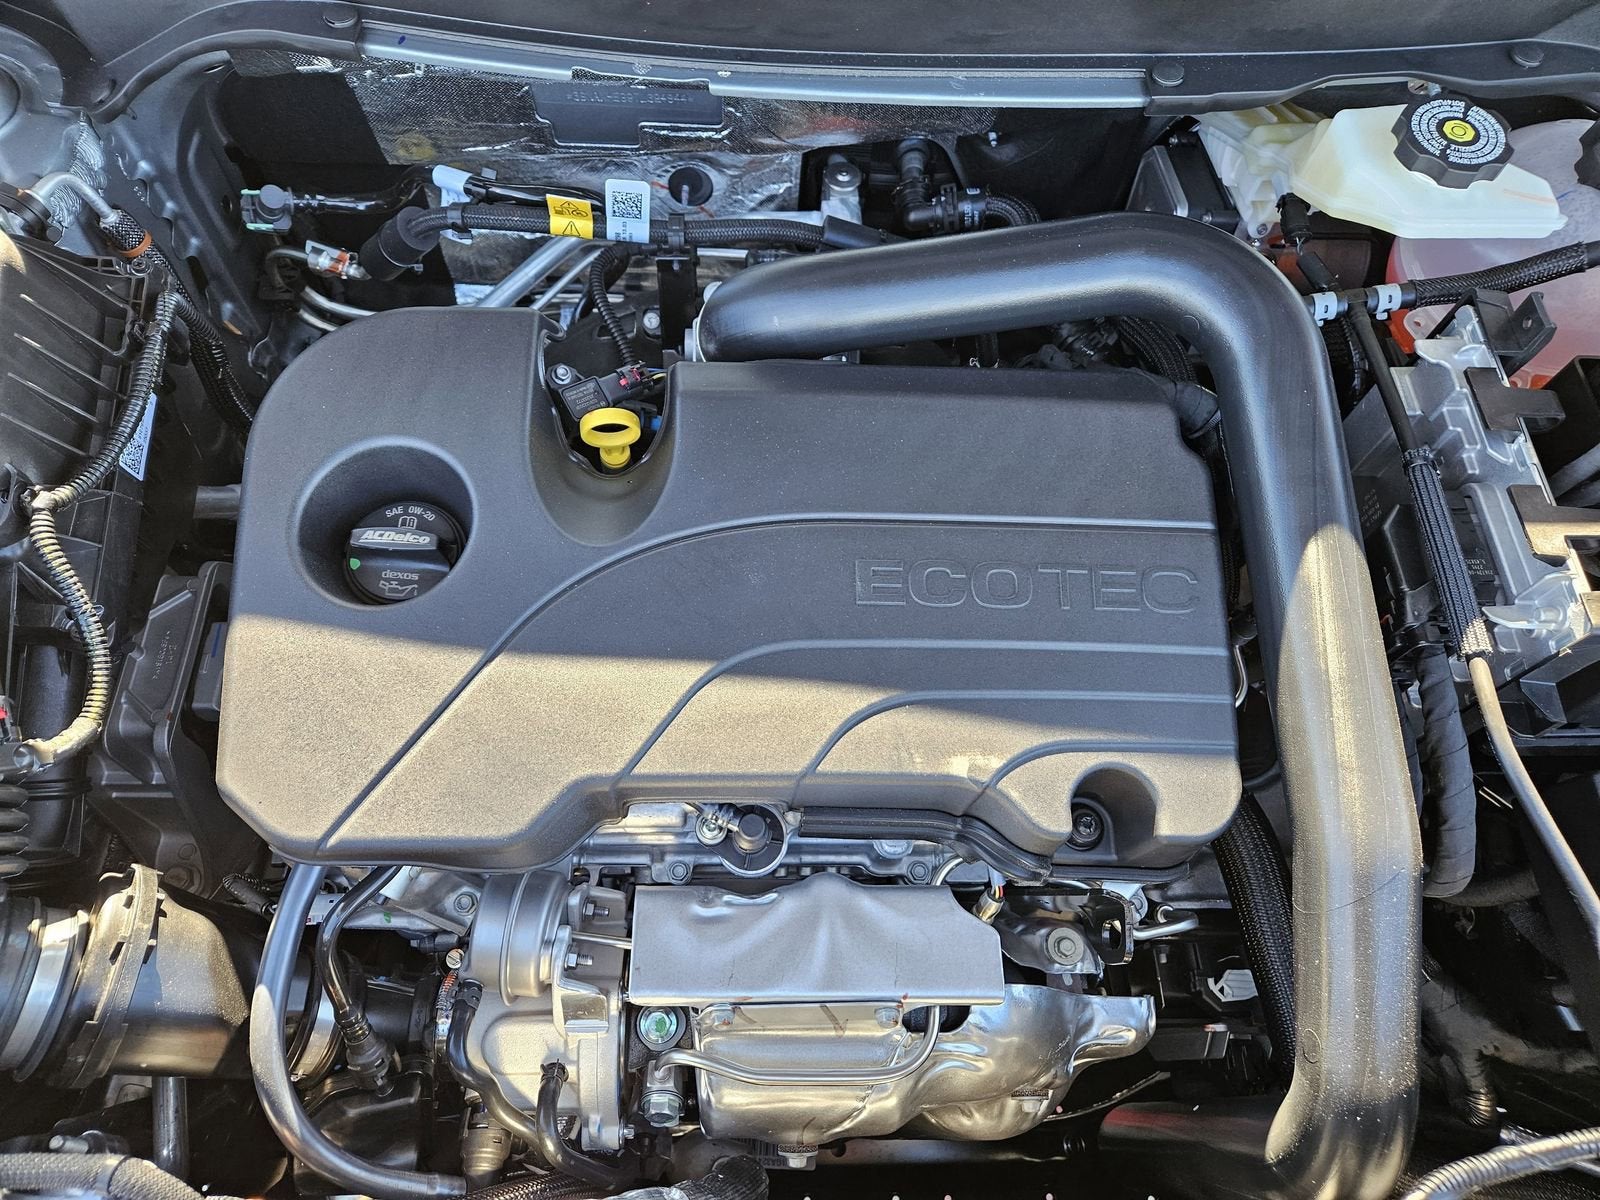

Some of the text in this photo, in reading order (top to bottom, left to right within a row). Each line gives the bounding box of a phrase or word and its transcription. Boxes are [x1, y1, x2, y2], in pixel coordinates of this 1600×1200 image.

[1428, 138, 1444, 149] ONLY
[1429, 131, 1447, 146] FILLER
[385, 505, 436, 521] SAE 0W-20
[361, 530, 431, 544] ACDelco
[381, 569, 420, 580] dexos
[855, 559, 1198, 614] ECOTEC
